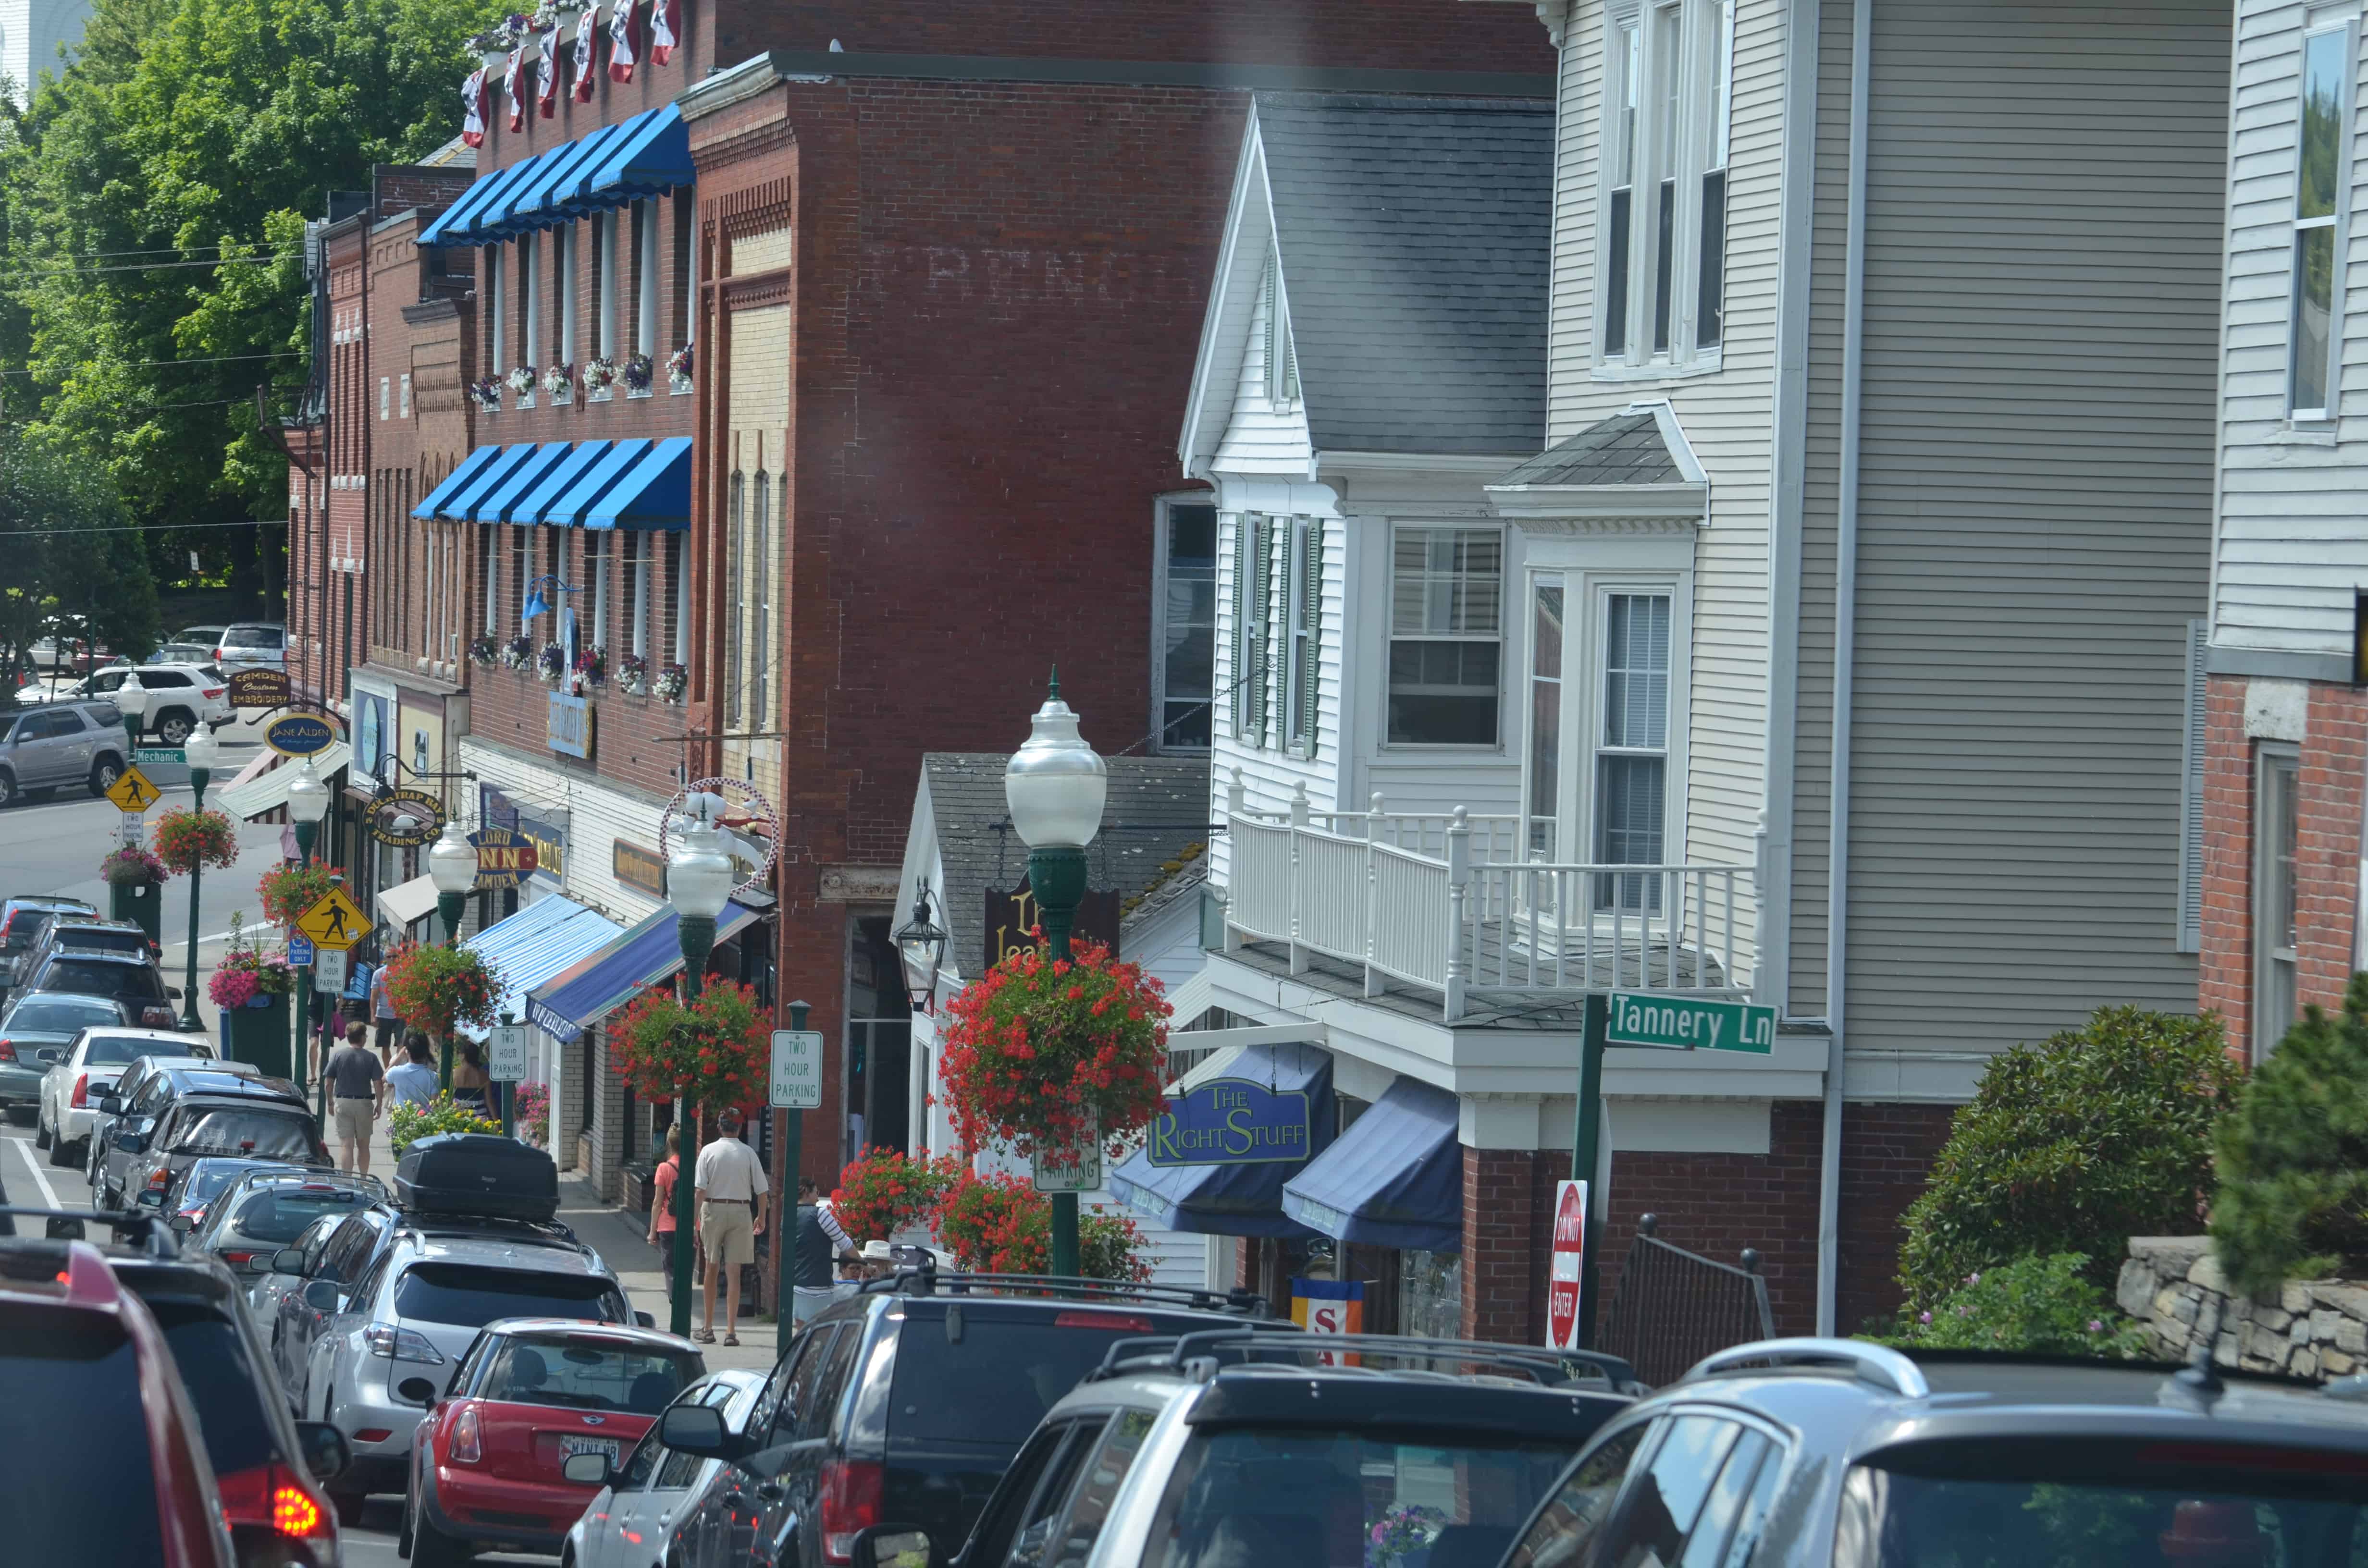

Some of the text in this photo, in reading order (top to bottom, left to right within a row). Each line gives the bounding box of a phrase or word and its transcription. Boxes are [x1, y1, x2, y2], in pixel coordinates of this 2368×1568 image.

[235, 672, 286, 683] CAMDEN
[242, 682, 278, 691] Custom
[233, 696, 287, 704] EMBROIDERY
[138, 751, 178, 762] Mechanic
[425, 796, 443, 813] BAY
[371, 829, 420, 845] TRADING
[477, 830, 511, 845] LORD
[480, 848, 520, 869] NN
[476, 871, 519, 888] AMDEN
[327, 955, 338, 964] TWO
[324, 967, 339, 976] HOUR
[319, 979, 342, 988] PARKING
[1616, 995, 1771, 1048] Tannery Ln
[501, 1033, 515, 1044] TWO
[499, 1049, 518, 1058] HOUR
[788, 1041, 806, 1055] TWO
[493, 1064, 523, 1074] PARKING
[784, 1063, 809, 1077] HOUR
[776, 1083, 816, 1098] PARKING
[1203, 1086, 1250, 1110] THE
[1557, 1216, 1580, 1242] DO NOT
[1554, 1291, 1573, 1319] ENTER
